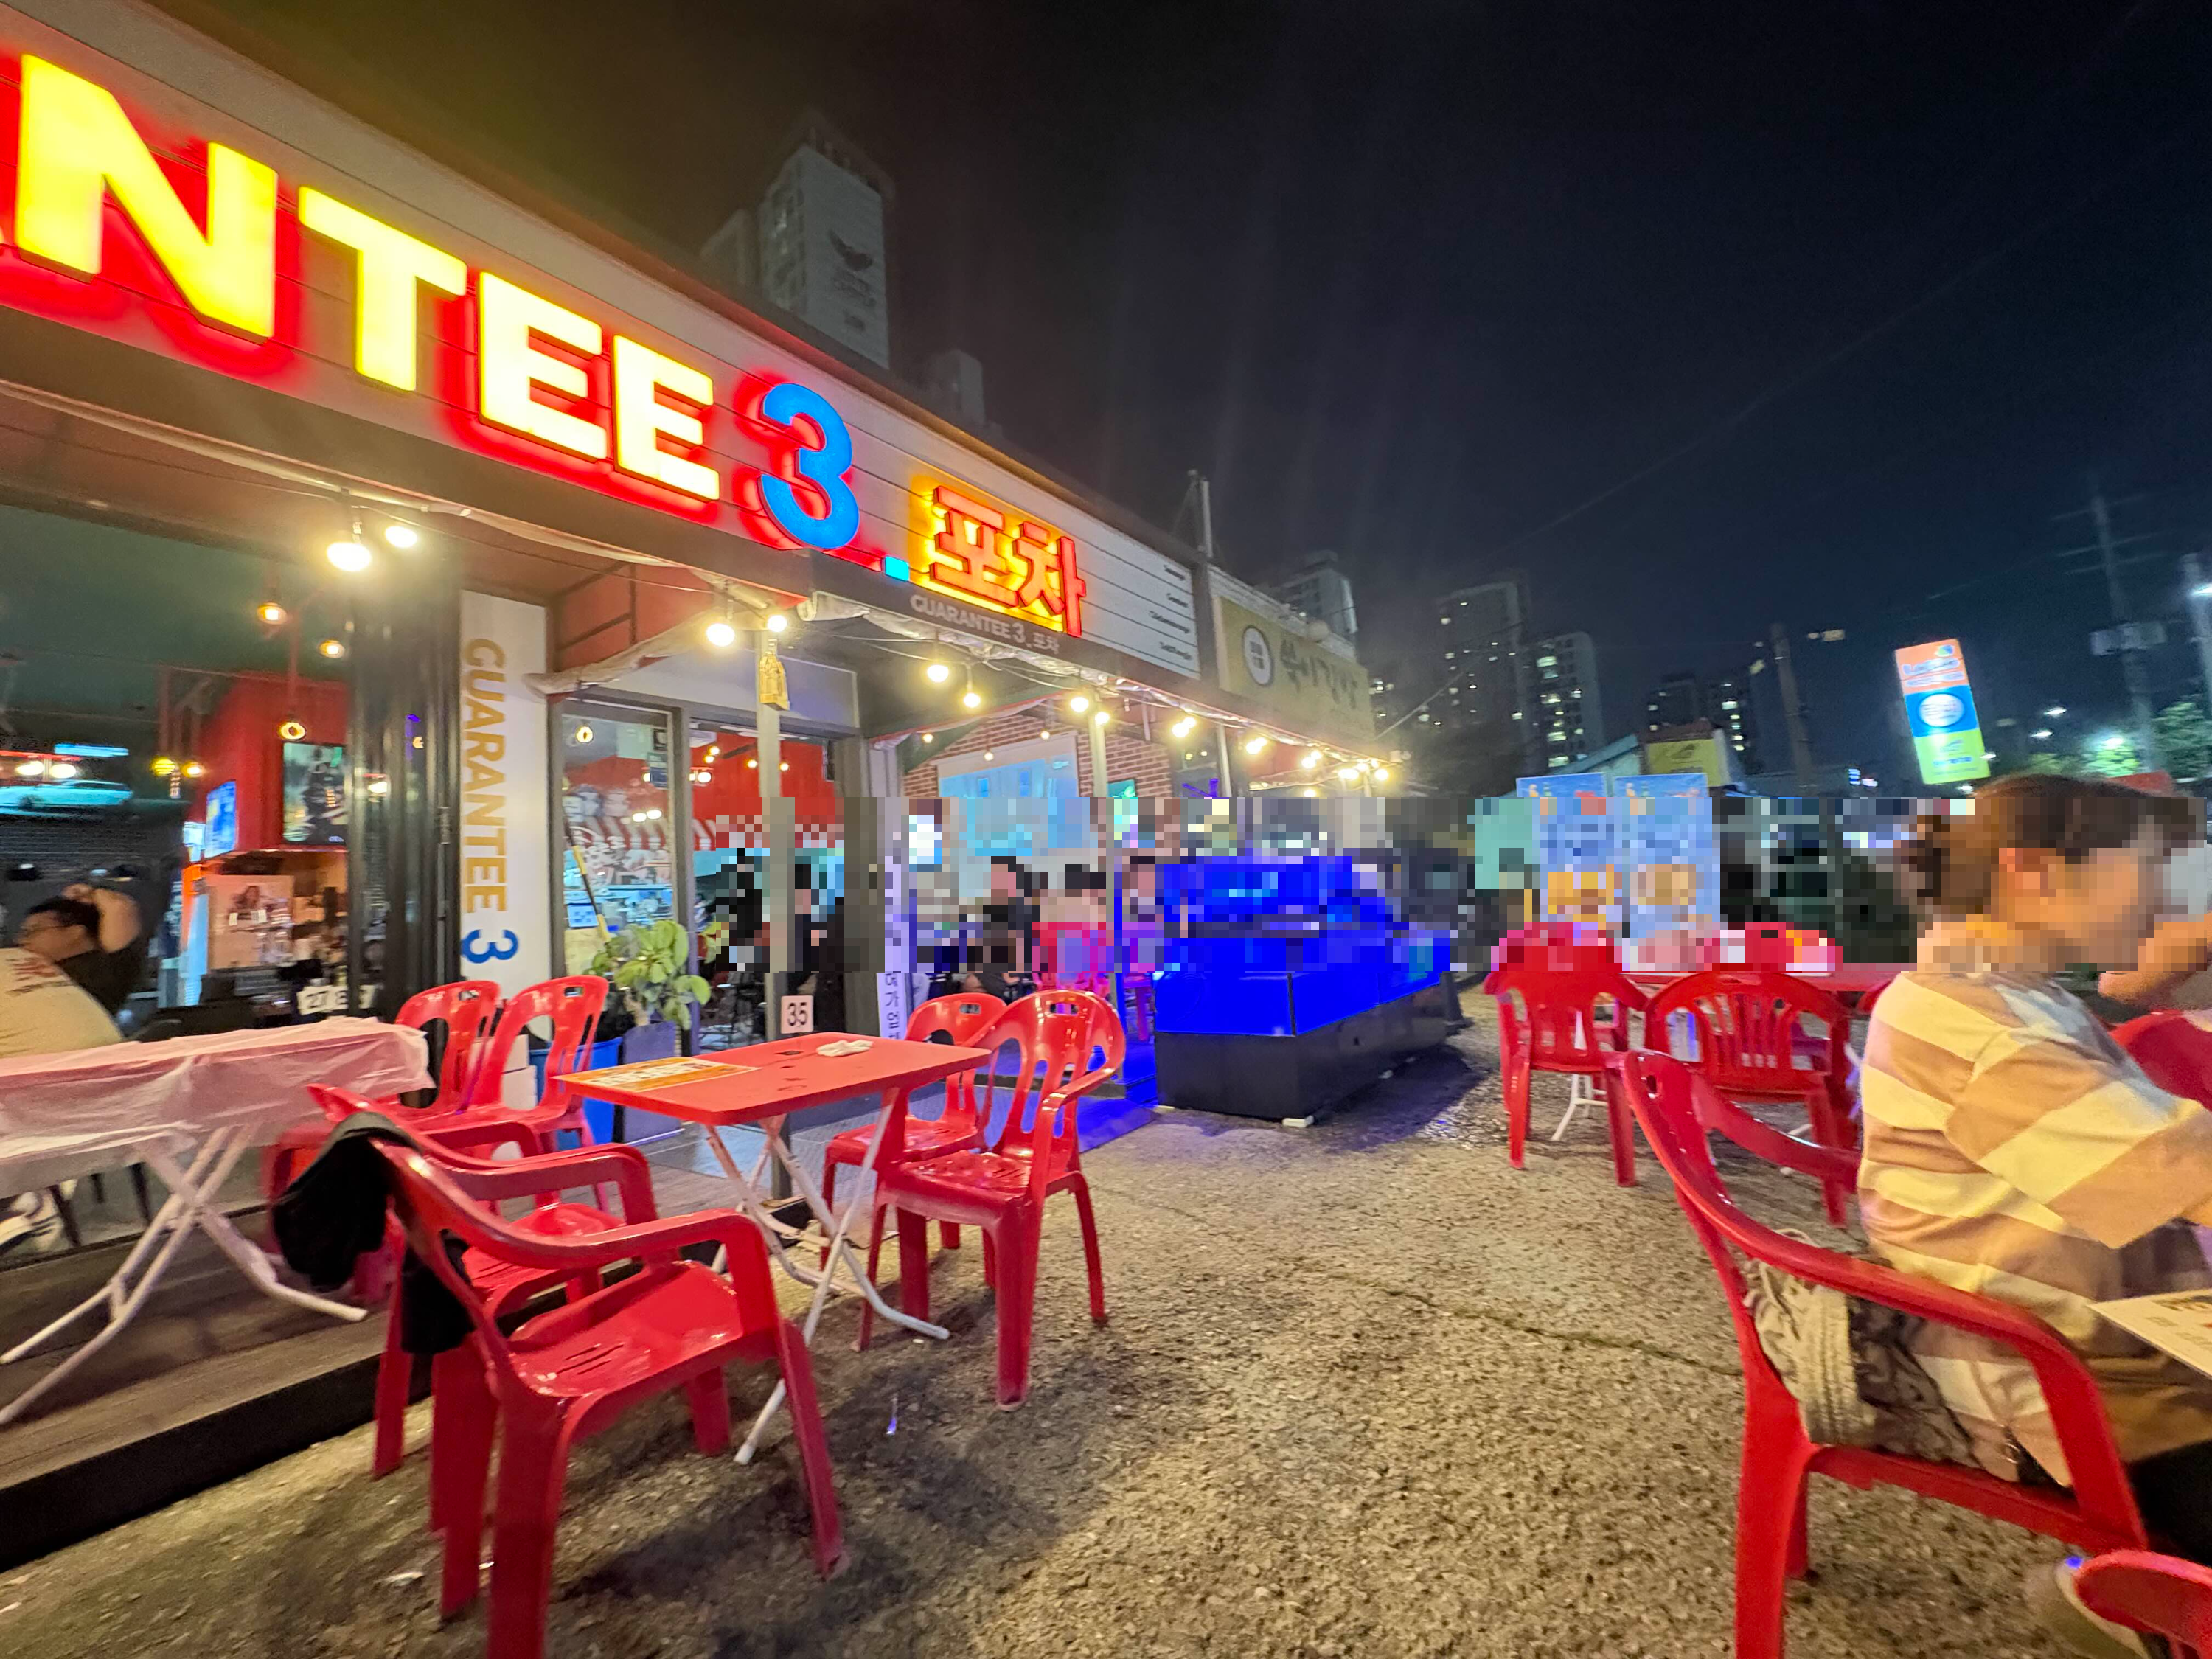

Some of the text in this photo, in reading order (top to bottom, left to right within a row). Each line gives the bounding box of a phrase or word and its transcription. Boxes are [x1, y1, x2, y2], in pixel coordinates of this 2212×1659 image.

[0, 55, 720, 501] NTEE
[930, 486, 1085, 638] 포차
[910, 594, 1011, 639] GUARANTEE
[460, 638, 519, 964] GUARANTEE 3
[787, 1001, 808, 1026] 35
